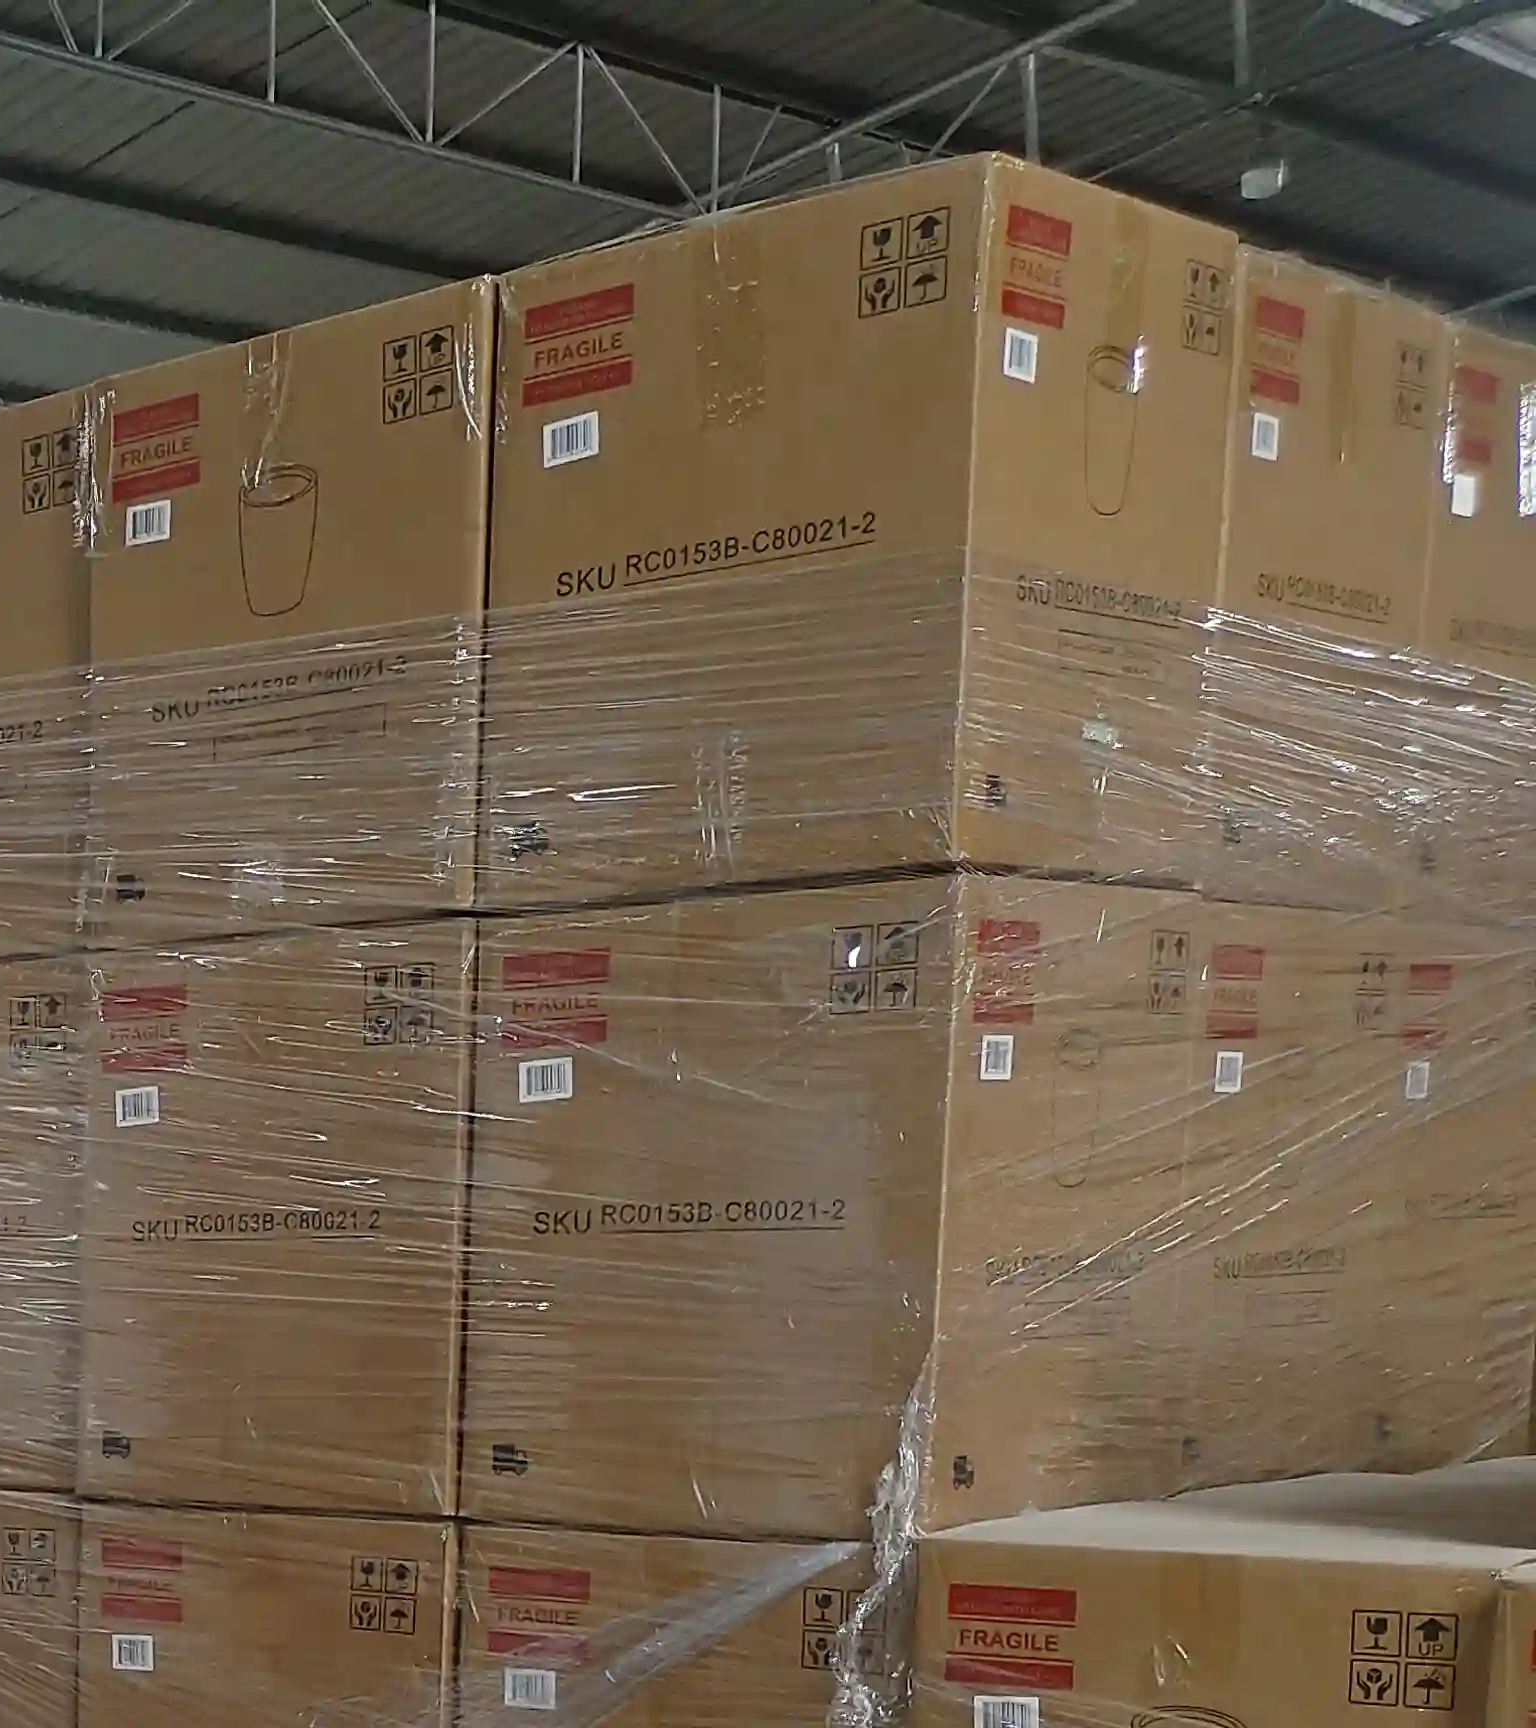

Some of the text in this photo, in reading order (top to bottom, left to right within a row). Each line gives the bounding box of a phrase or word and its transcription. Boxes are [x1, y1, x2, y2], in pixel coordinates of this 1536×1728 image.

[533, 331, 625, 369] FRAGILE
[119, 436, 194, 470] FRAGILE
[555, 511, 877, 598] SKU RC0153B-C80021-2
[109, 1021, 181, 1044] FRAGILE
[132, 1217, 178, 1242] SKU
[532, 1199, 846, 1236] SKU RC0153B-C80021-2
[959, 1628, 1060, 1652] FRAGILE
[1418, 1642, 1444, 1657] UP
